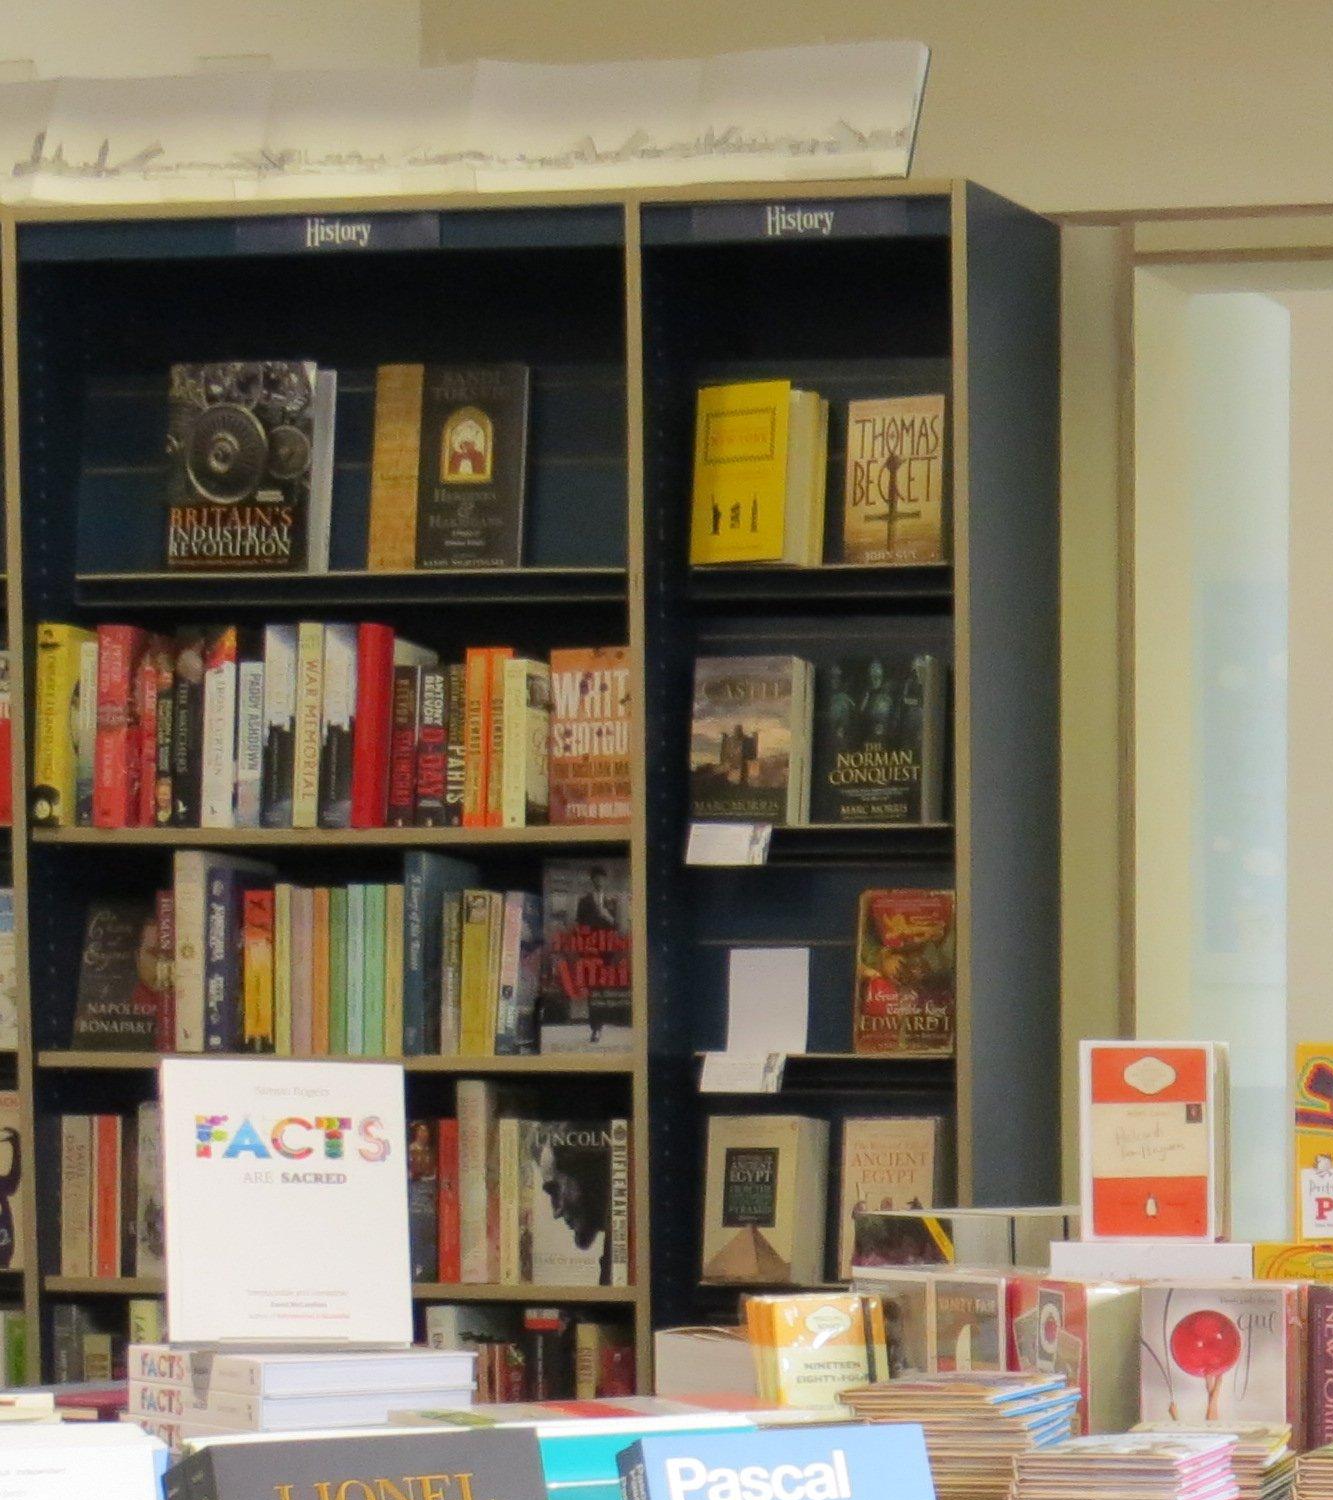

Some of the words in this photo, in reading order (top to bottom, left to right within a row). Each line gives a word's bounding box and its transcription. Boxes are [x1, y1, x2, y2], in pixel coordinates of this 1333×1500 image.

[306, 218, 371, 248] History
[766, 206, 834, 236] History
[854, 413, 940, 458] THOMAS
[851, 456, 938, 507] BECKET
[169, 506, 293, 530] BRITAIN'S
[836, 750, 913, 768] NORMAN
[827, 764, 921, 785] CONQUEST
[195, 1113, 391, 1164] FACTS
[850, 1149, 929, 1168] ANCIENT
[281, 1171, 348, 1185] SACRED
